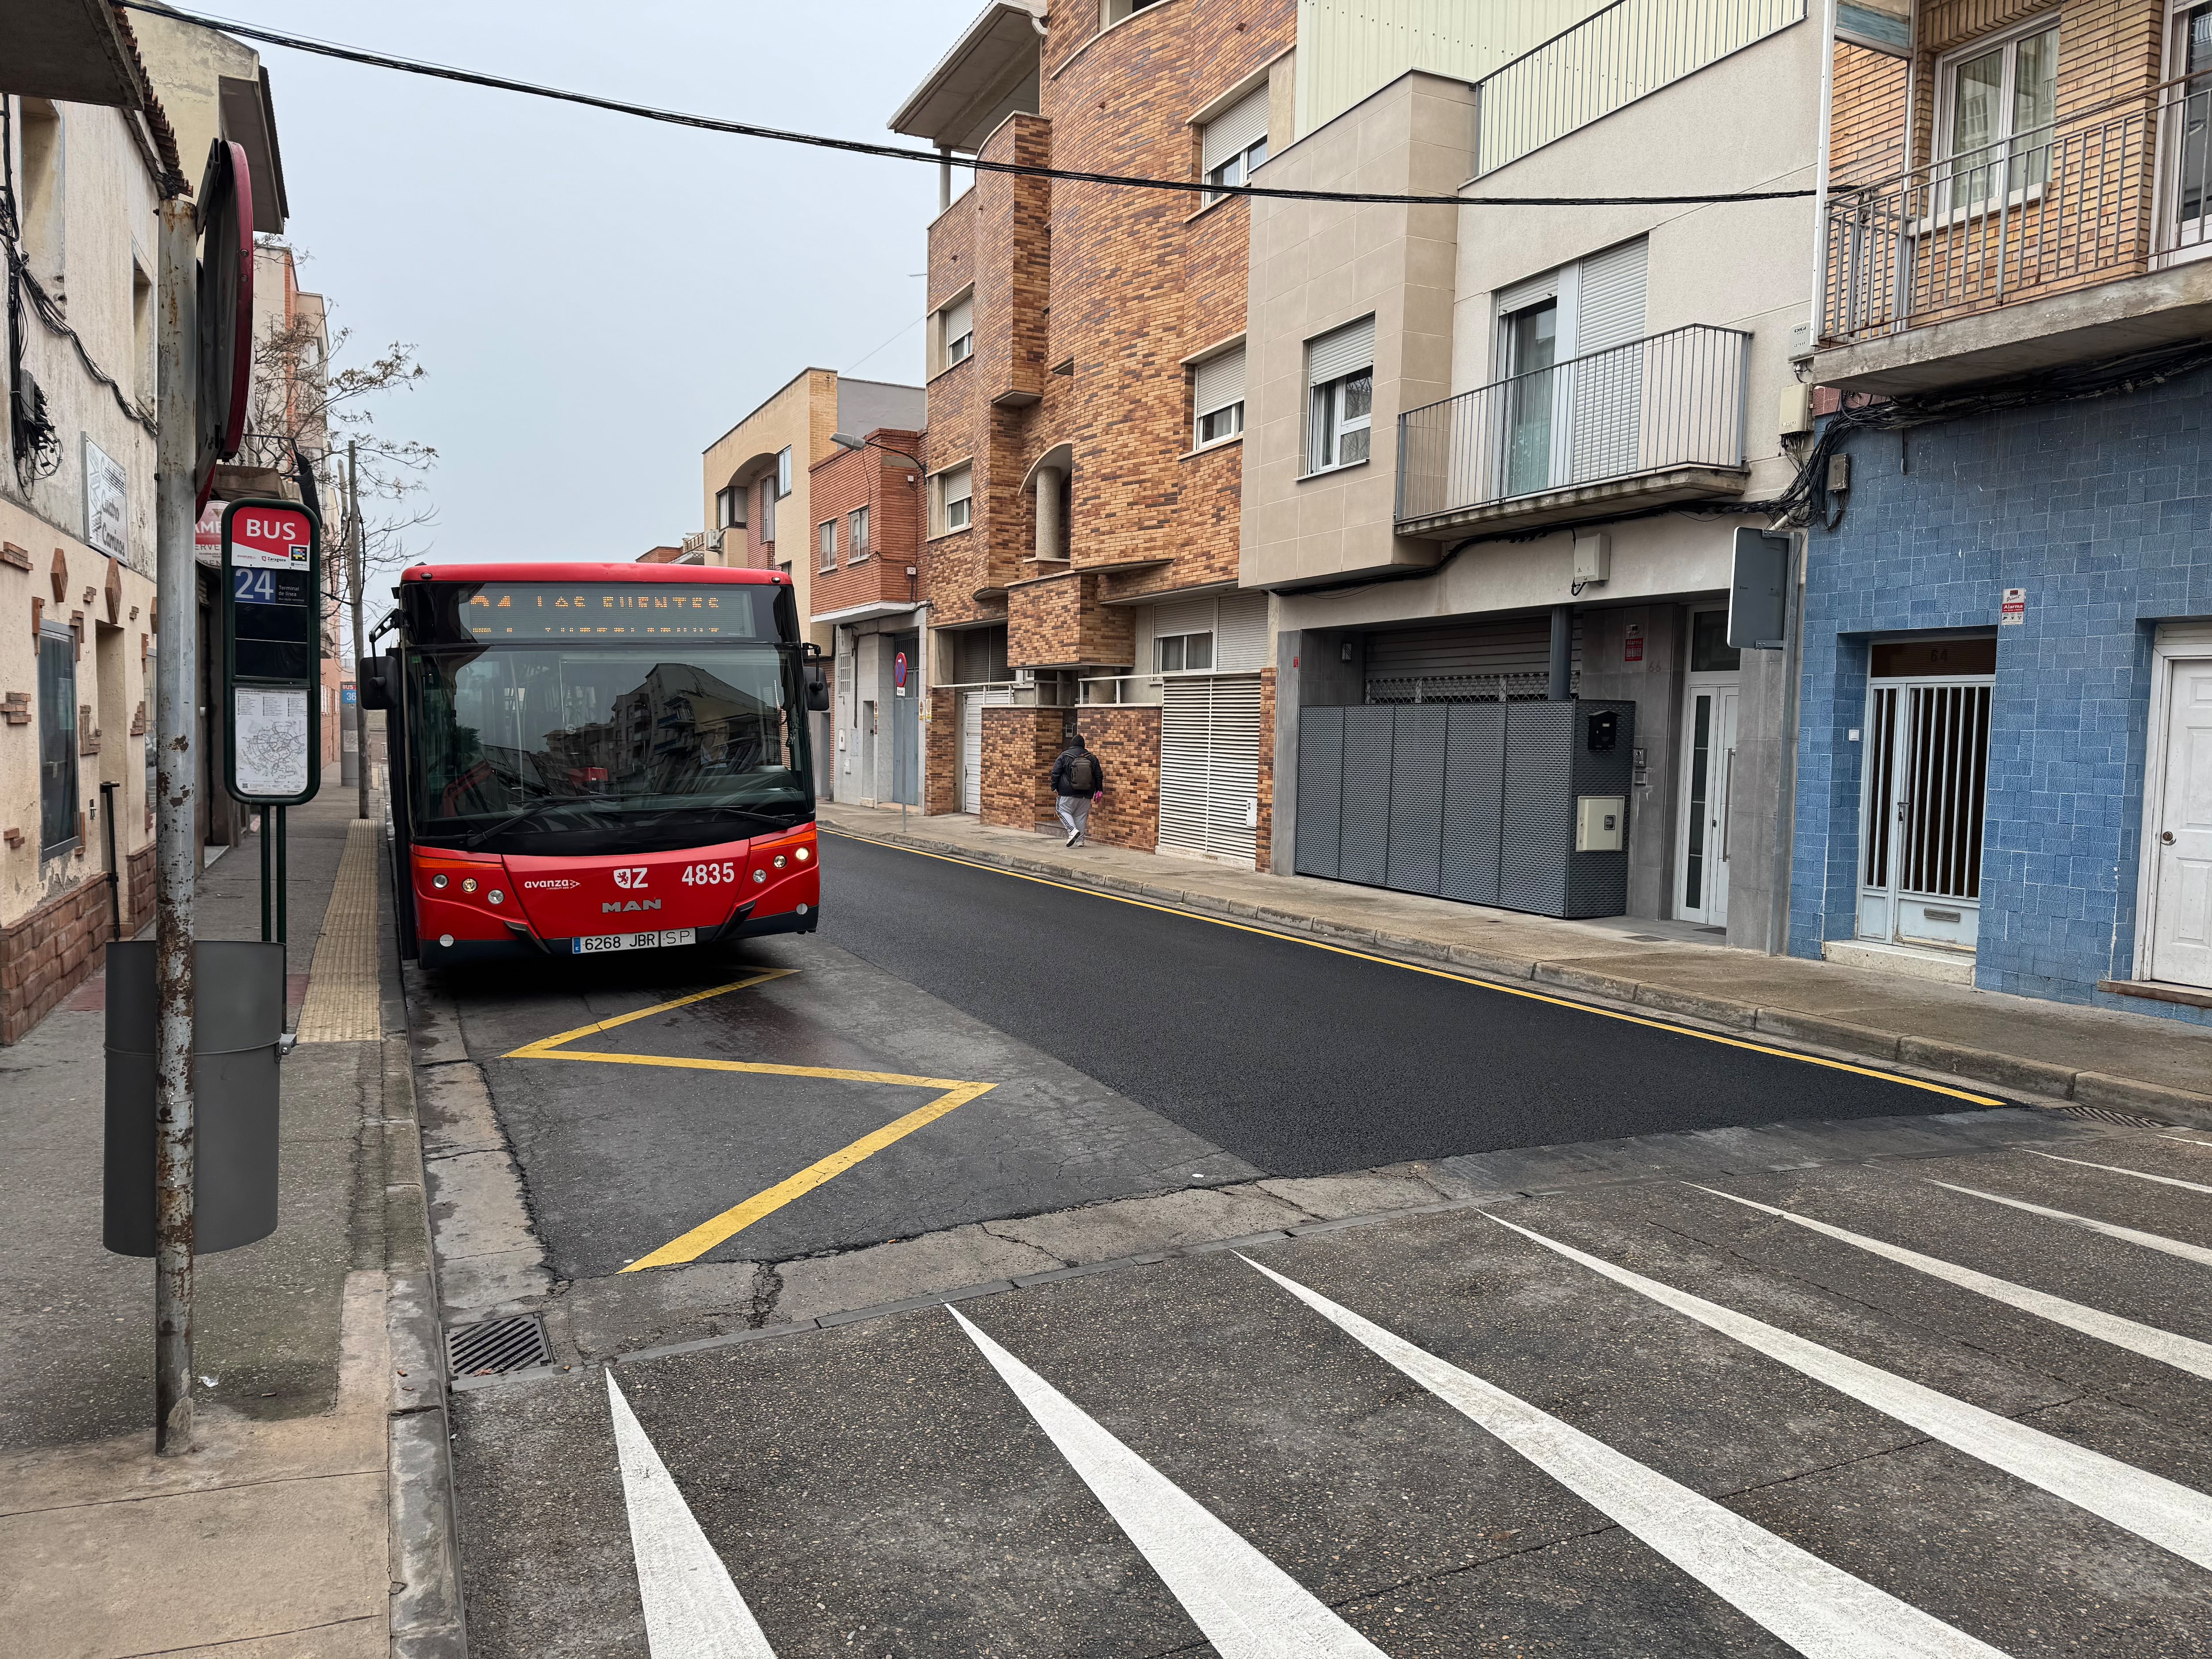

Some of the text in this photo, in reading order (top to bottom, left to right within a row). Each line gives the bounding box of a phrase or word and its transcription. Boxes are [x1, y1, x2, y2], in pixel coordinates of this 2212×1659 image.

[246, 519, 296, 540] BUS
[235, 568, 274, 600] 24
[682, 862, 735, 886] 4835
[524, 879, 569, 888] avanza
[602, 899, 661, 913] MAN
[585, 937, 621, 950] 6268
[630, 934, 655, 947] JBR
